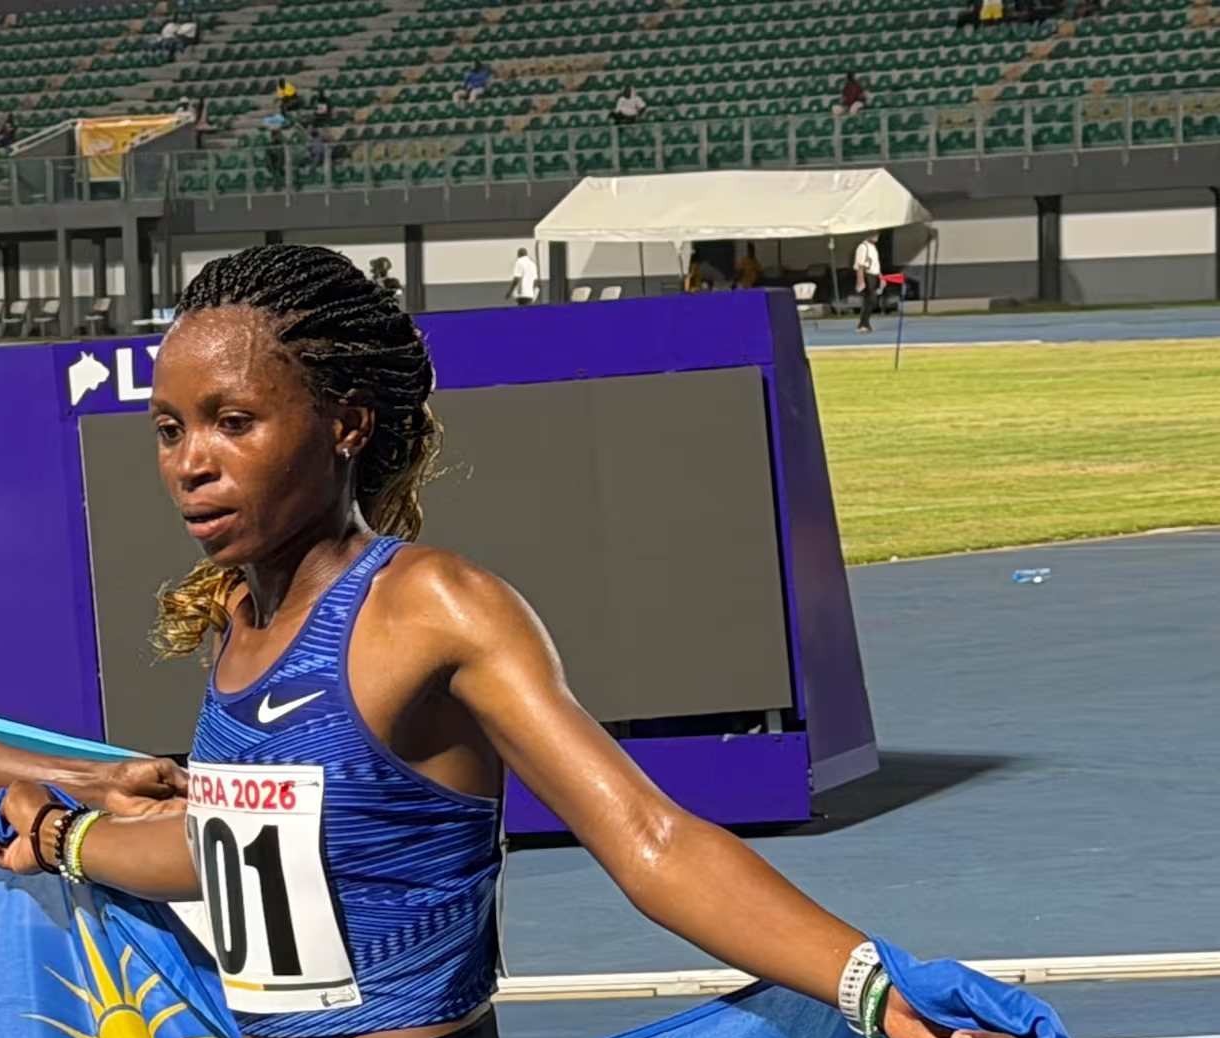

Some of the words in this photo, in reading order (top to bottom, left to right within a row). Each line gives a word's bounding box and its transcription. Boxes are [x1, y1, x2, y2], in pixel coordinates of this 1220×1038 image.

[116, 345, 160, 401] L
[188, 775, 228, 807] CRA
[232, 779, 296, 810] 2026
[187, 815, 303, 977] 01
